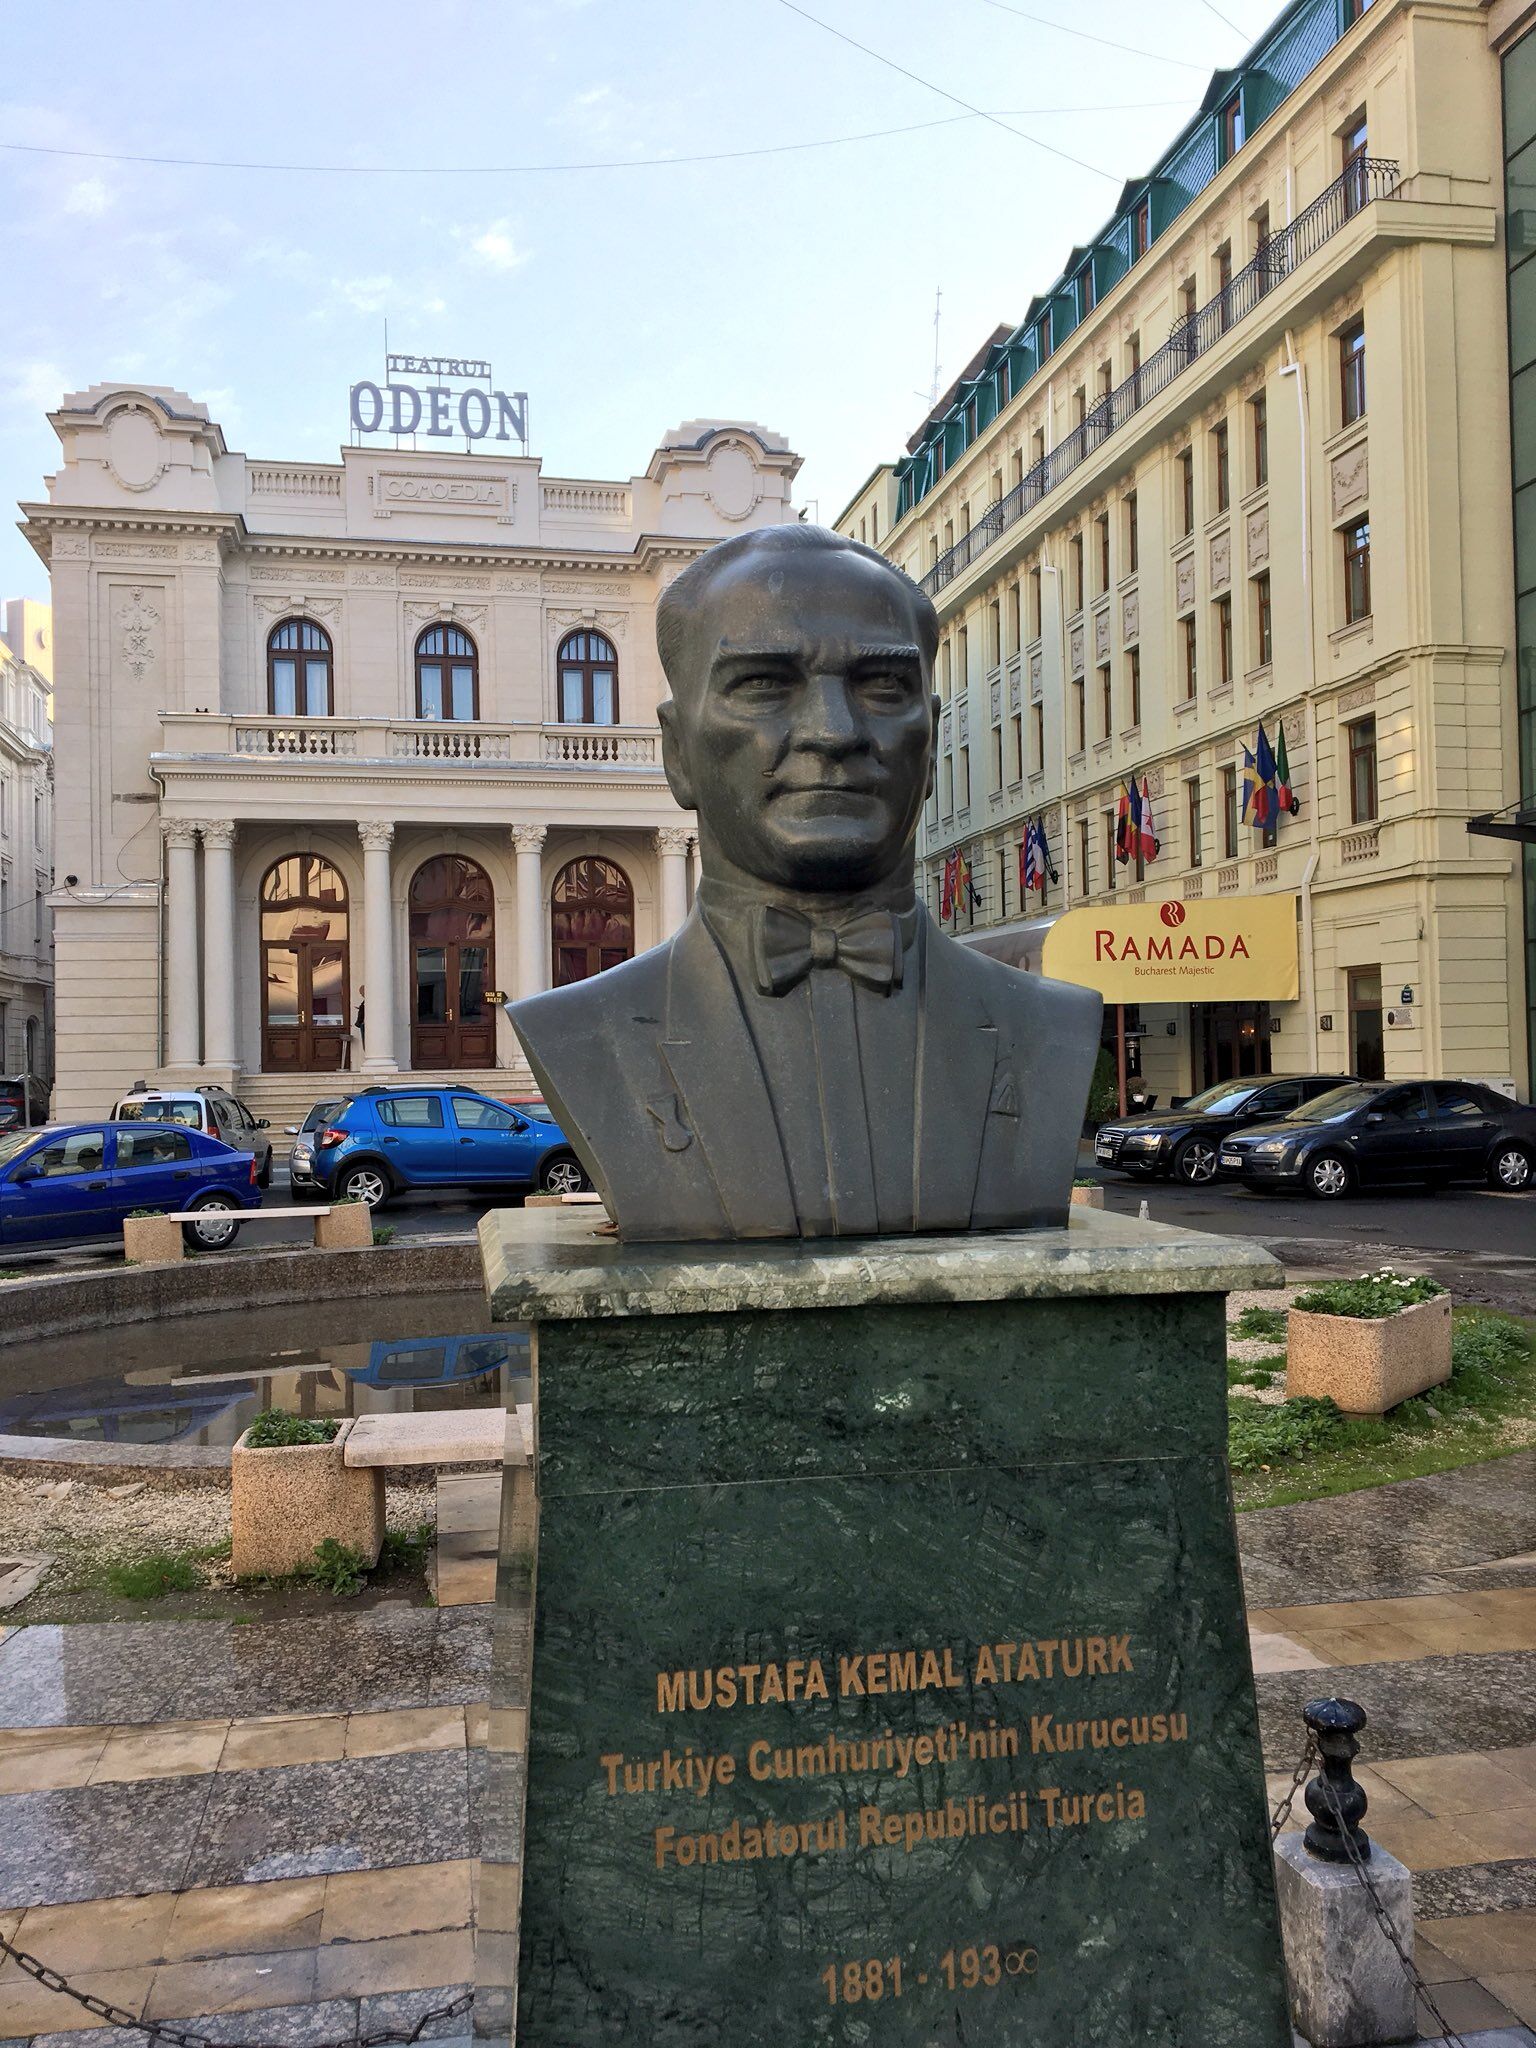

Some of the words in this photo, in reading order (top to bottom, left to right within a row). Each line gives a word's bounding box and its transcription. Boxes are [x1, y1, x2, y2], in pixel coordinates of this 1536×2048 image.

[387, 354, 491, 378] TEATRUL
[350, 380, 528, 442] ODEON
[1095, 930, 1251, 962] RAMADA
[1134, 965, 1177, 976] Bucharest
[1179, 965, 1215, 977] Majestic
[657, 1658, 829, 1713] MUSTAFA
[839, 1647, 963, 1697] KEMAL
[975, 1634, 1135, 1685] ATATURK
[601, 1748, 736, 1797] Türkiye
[1031, 1711, 1189, 1754] Kurucusu
[655, 1808, 847, 1869] Fondatorul
[859, 1791, 1029, 1852] Republicii
[1039, 1782, 1147, 1826] Turcia
[821, 1953, 902, 2005] 1881
